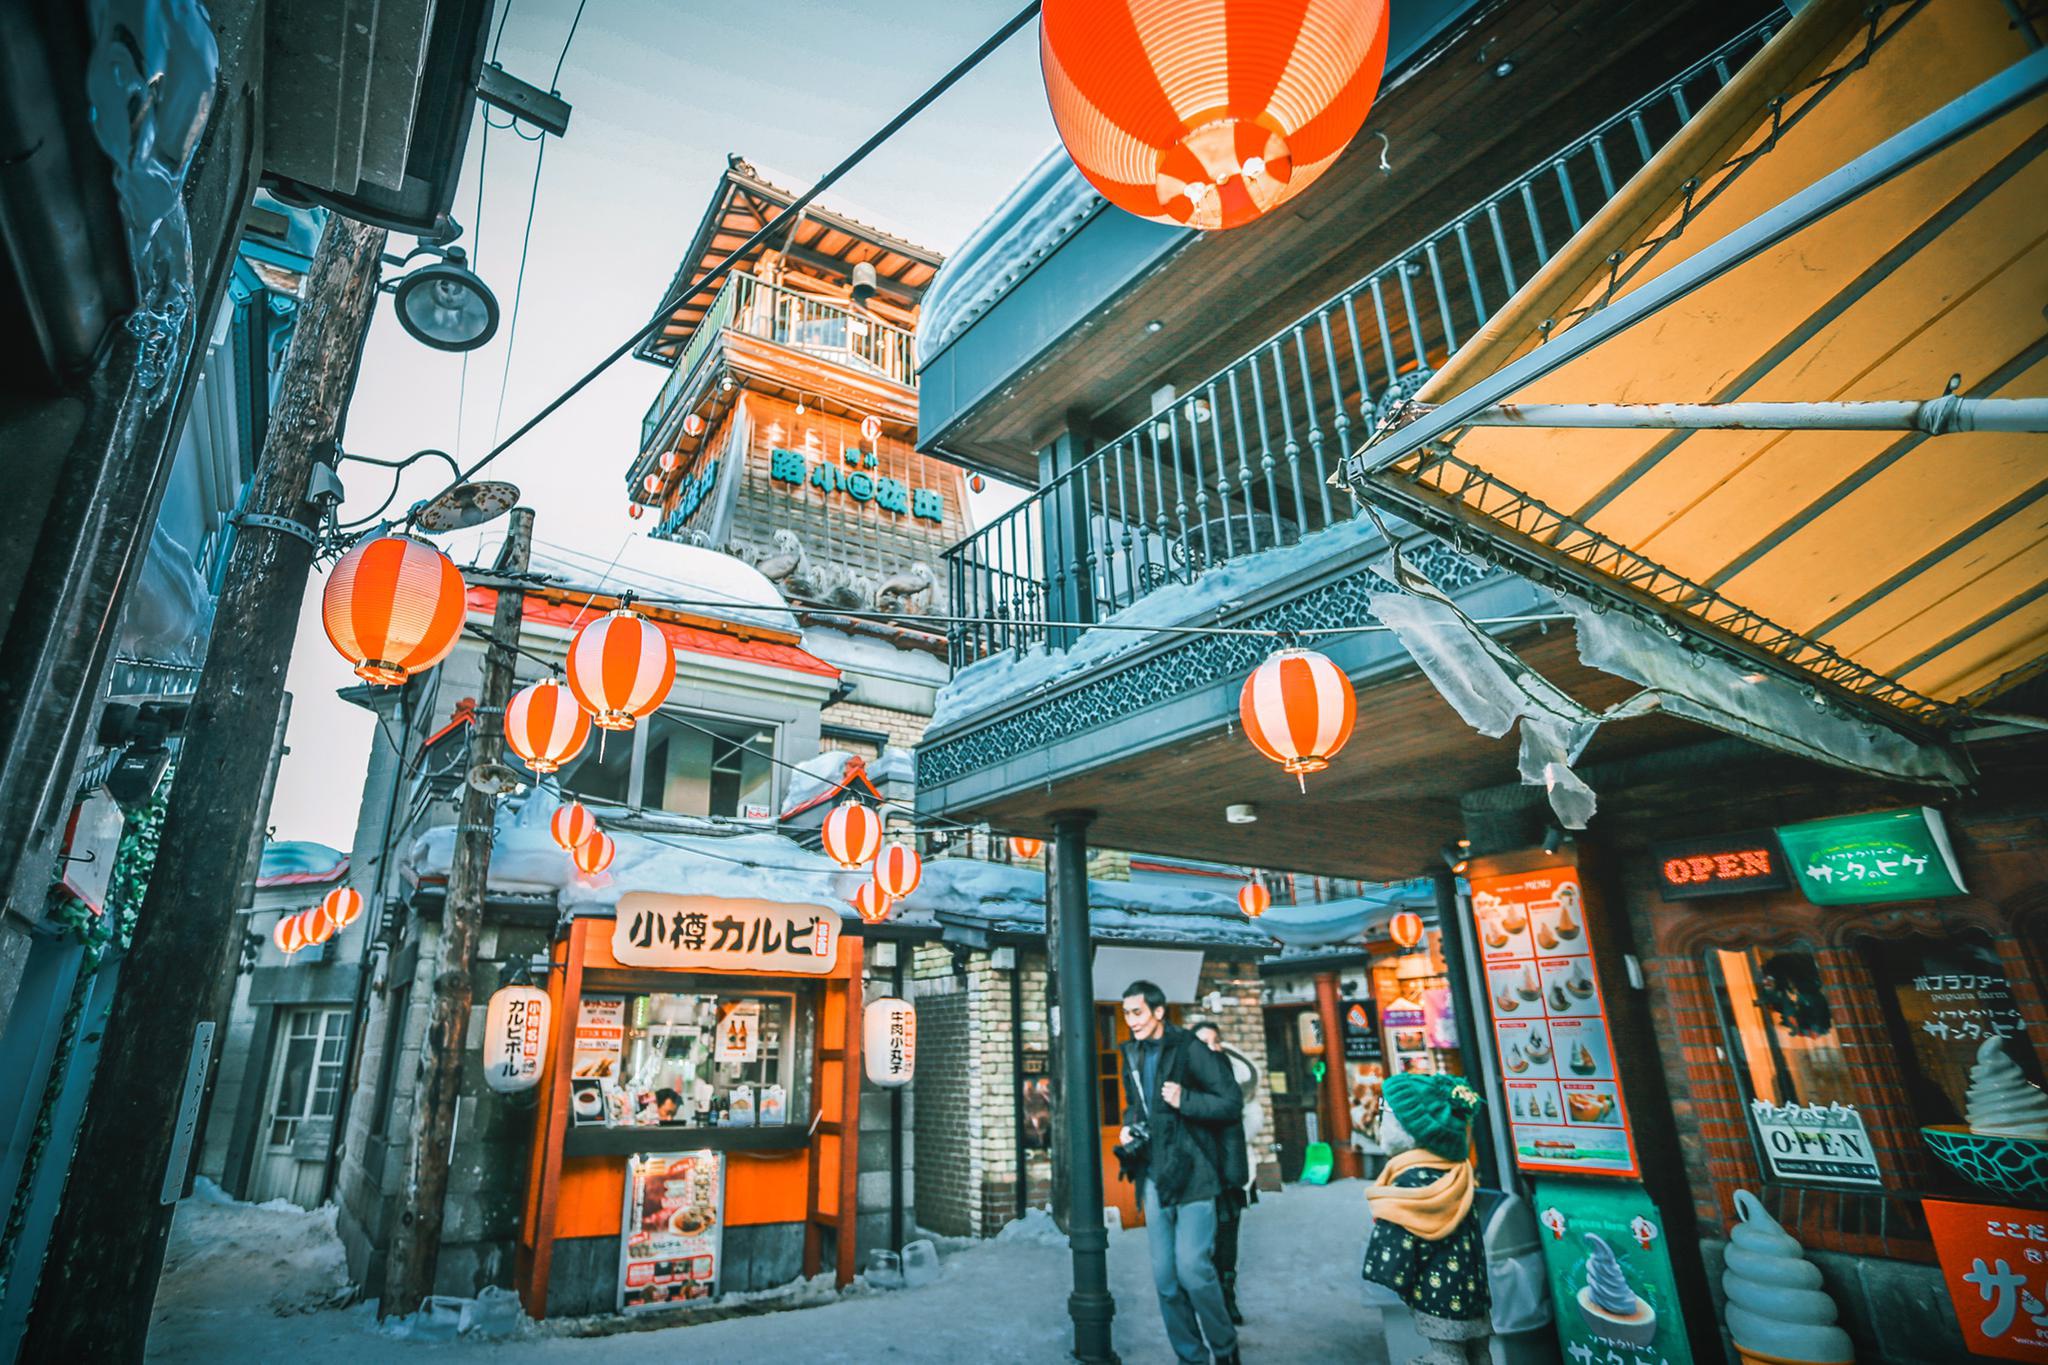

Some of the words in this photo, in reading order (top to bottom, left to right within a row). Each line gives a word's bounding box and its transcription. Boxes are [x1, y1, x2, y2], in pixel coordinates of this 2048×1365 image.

[1664, 850, 1772, 885] OPEN
[1806, 854, 1929, 884] サンタのヒゲ
[629, 910, 820, 956] 小樽カルビ
[1931, 992, 1975, 1002] popura
[1977, 990, 2008, 999] farm
